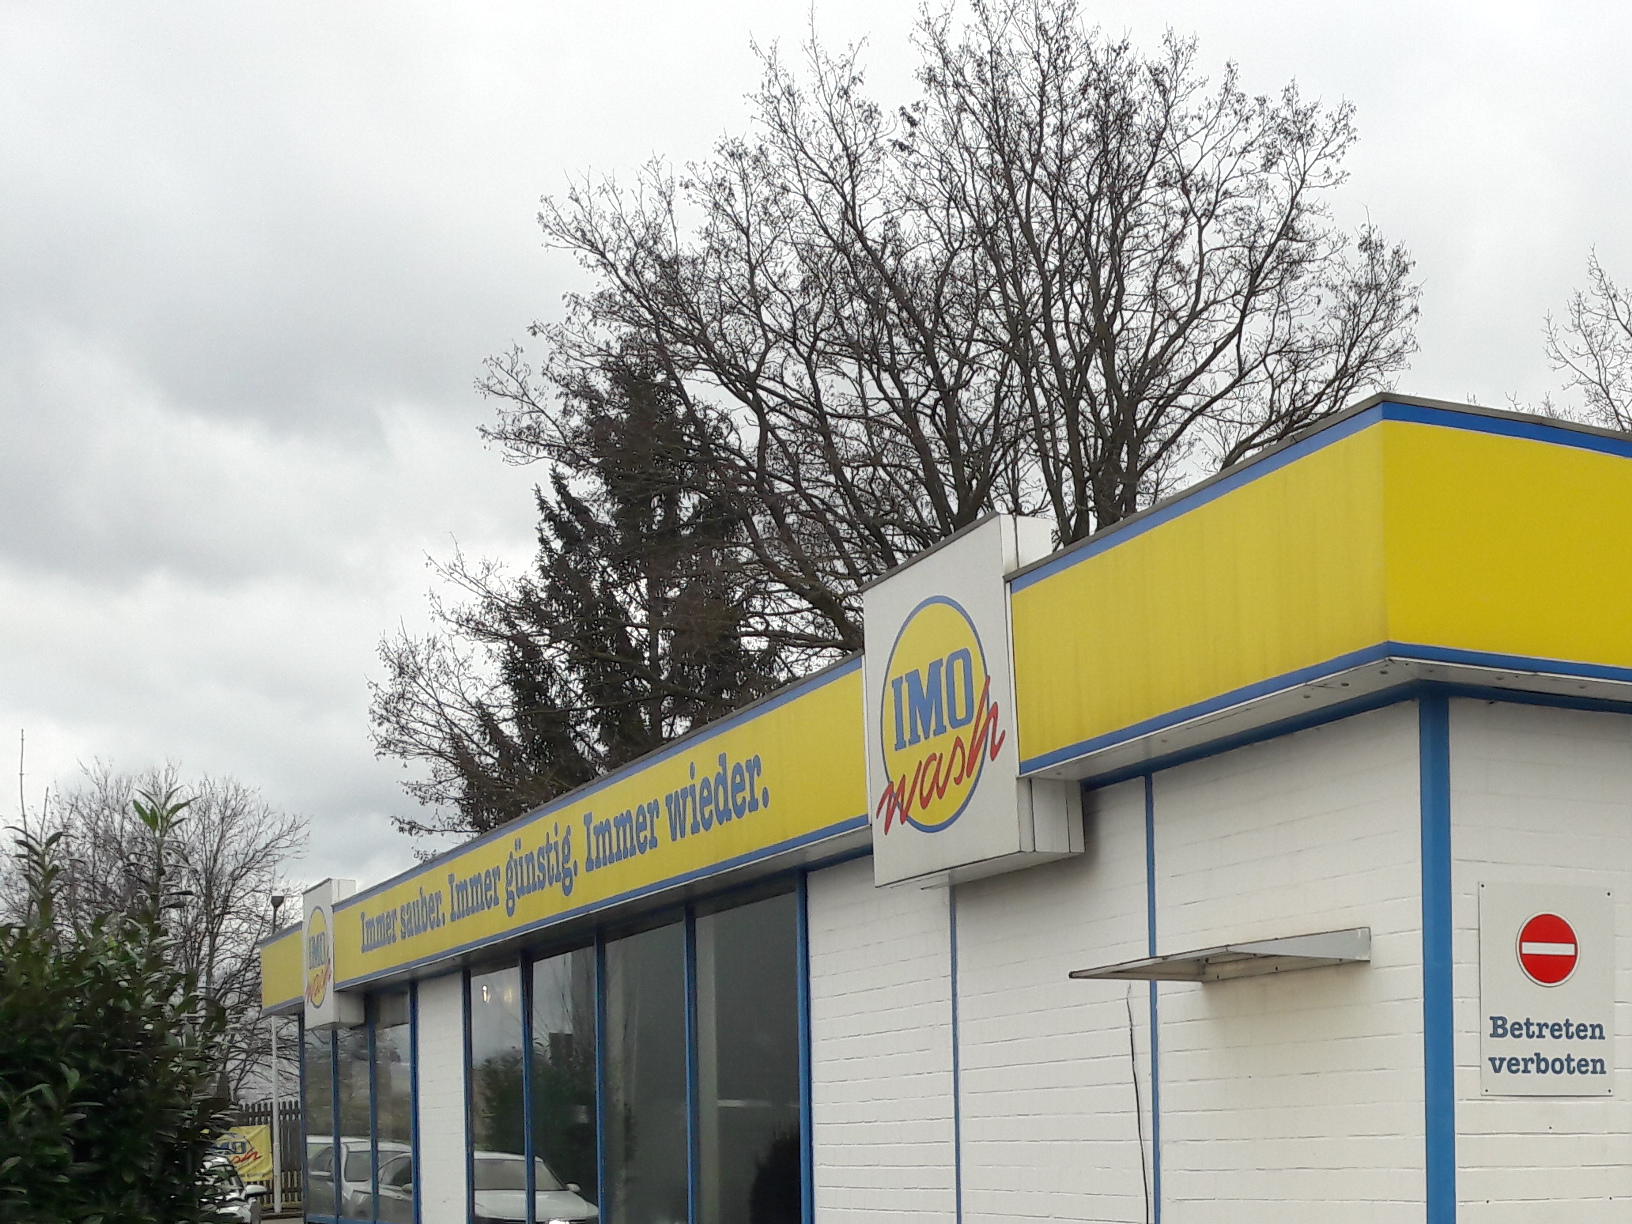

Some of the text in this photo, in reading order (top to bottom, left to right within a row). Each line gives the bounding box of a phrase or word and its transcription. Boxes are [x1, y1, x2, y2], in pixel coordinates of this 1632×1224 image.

[891, 647, 975, 751] IMO
[875, 674, 1006, 836] wash
[361, 752, 770, 954] Immer sauber. Immer günstig. Immer wieder.
[1488, 1052, 1607, 1076] verboten
[1489, 1015, 1606, 1040] Betreten
